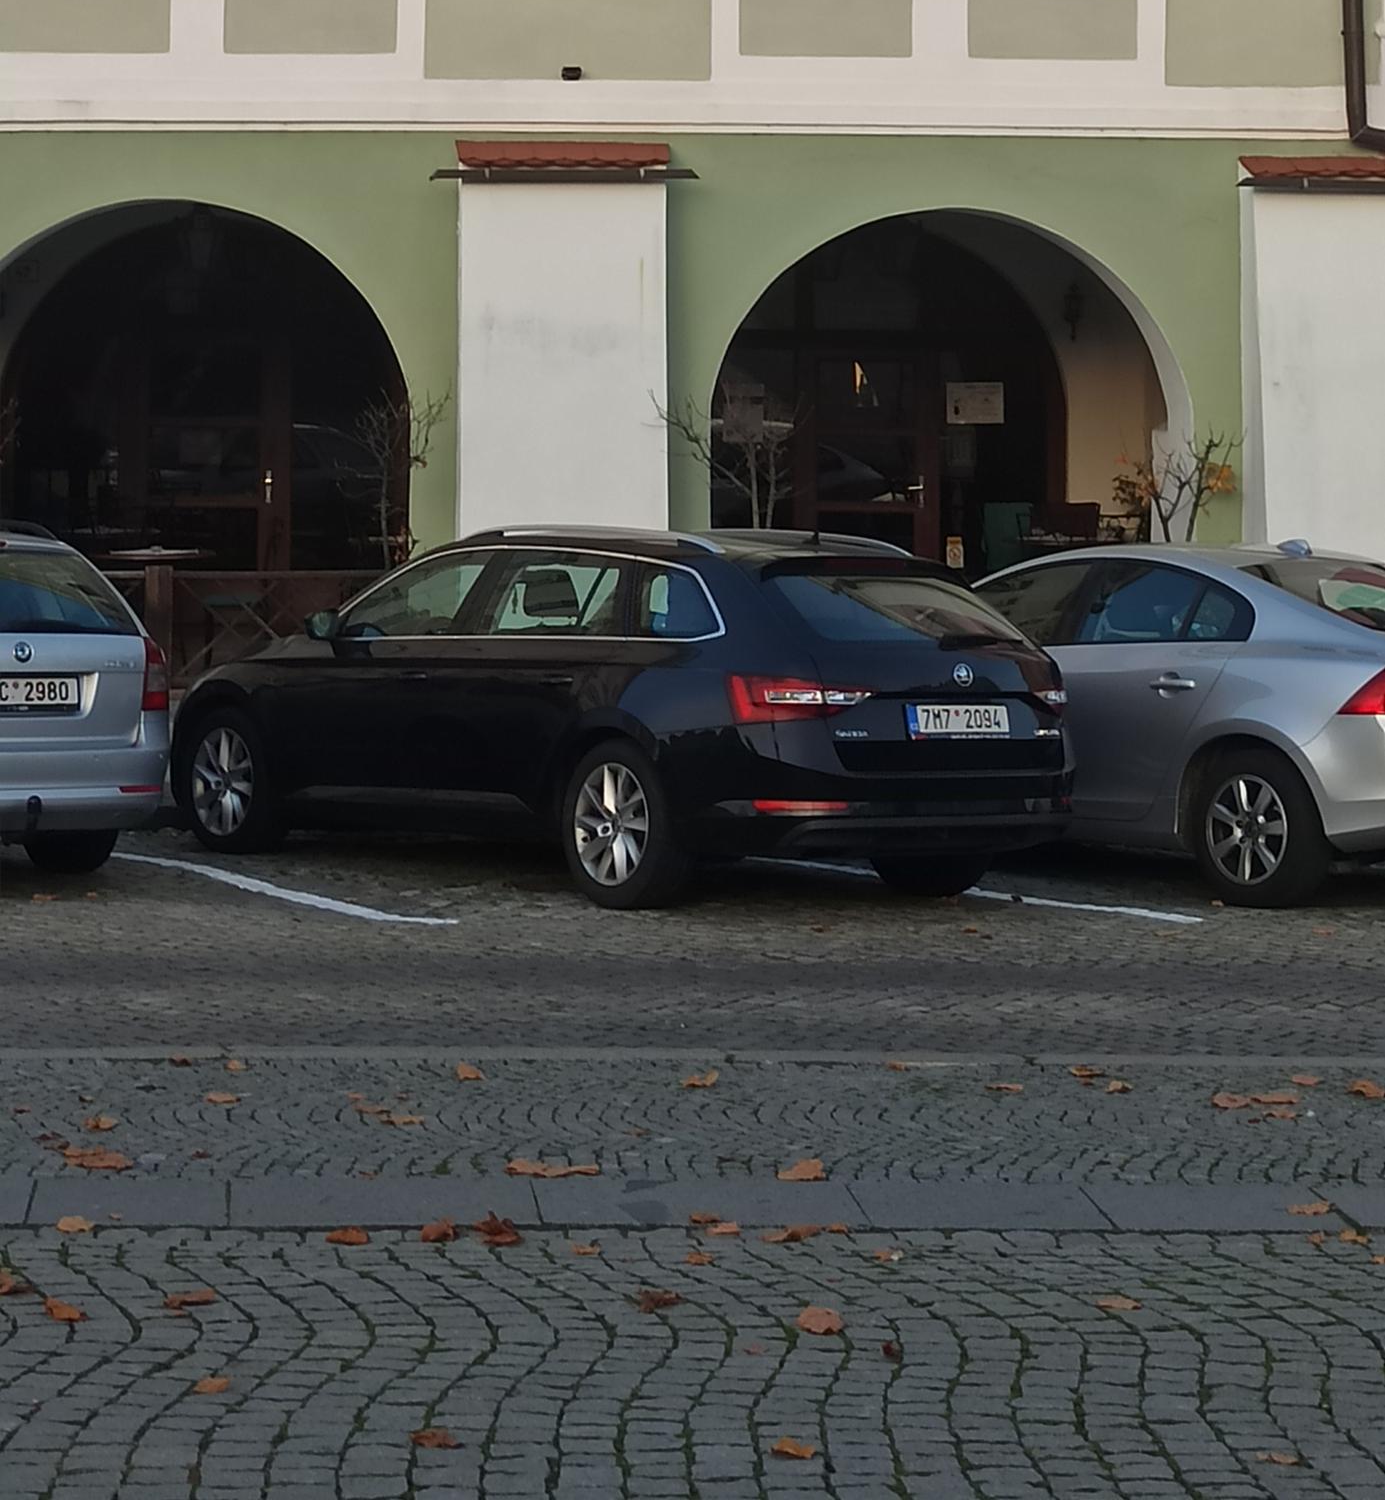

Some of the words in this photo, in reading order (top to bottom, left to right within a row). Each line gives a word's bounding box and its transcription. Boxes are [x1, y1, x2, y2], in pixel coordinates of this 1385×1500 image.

[24, 681, 69, 702] 2980
[921, 708, 951, 730] 7M7
[963, 708, 1001, 729] 2094
